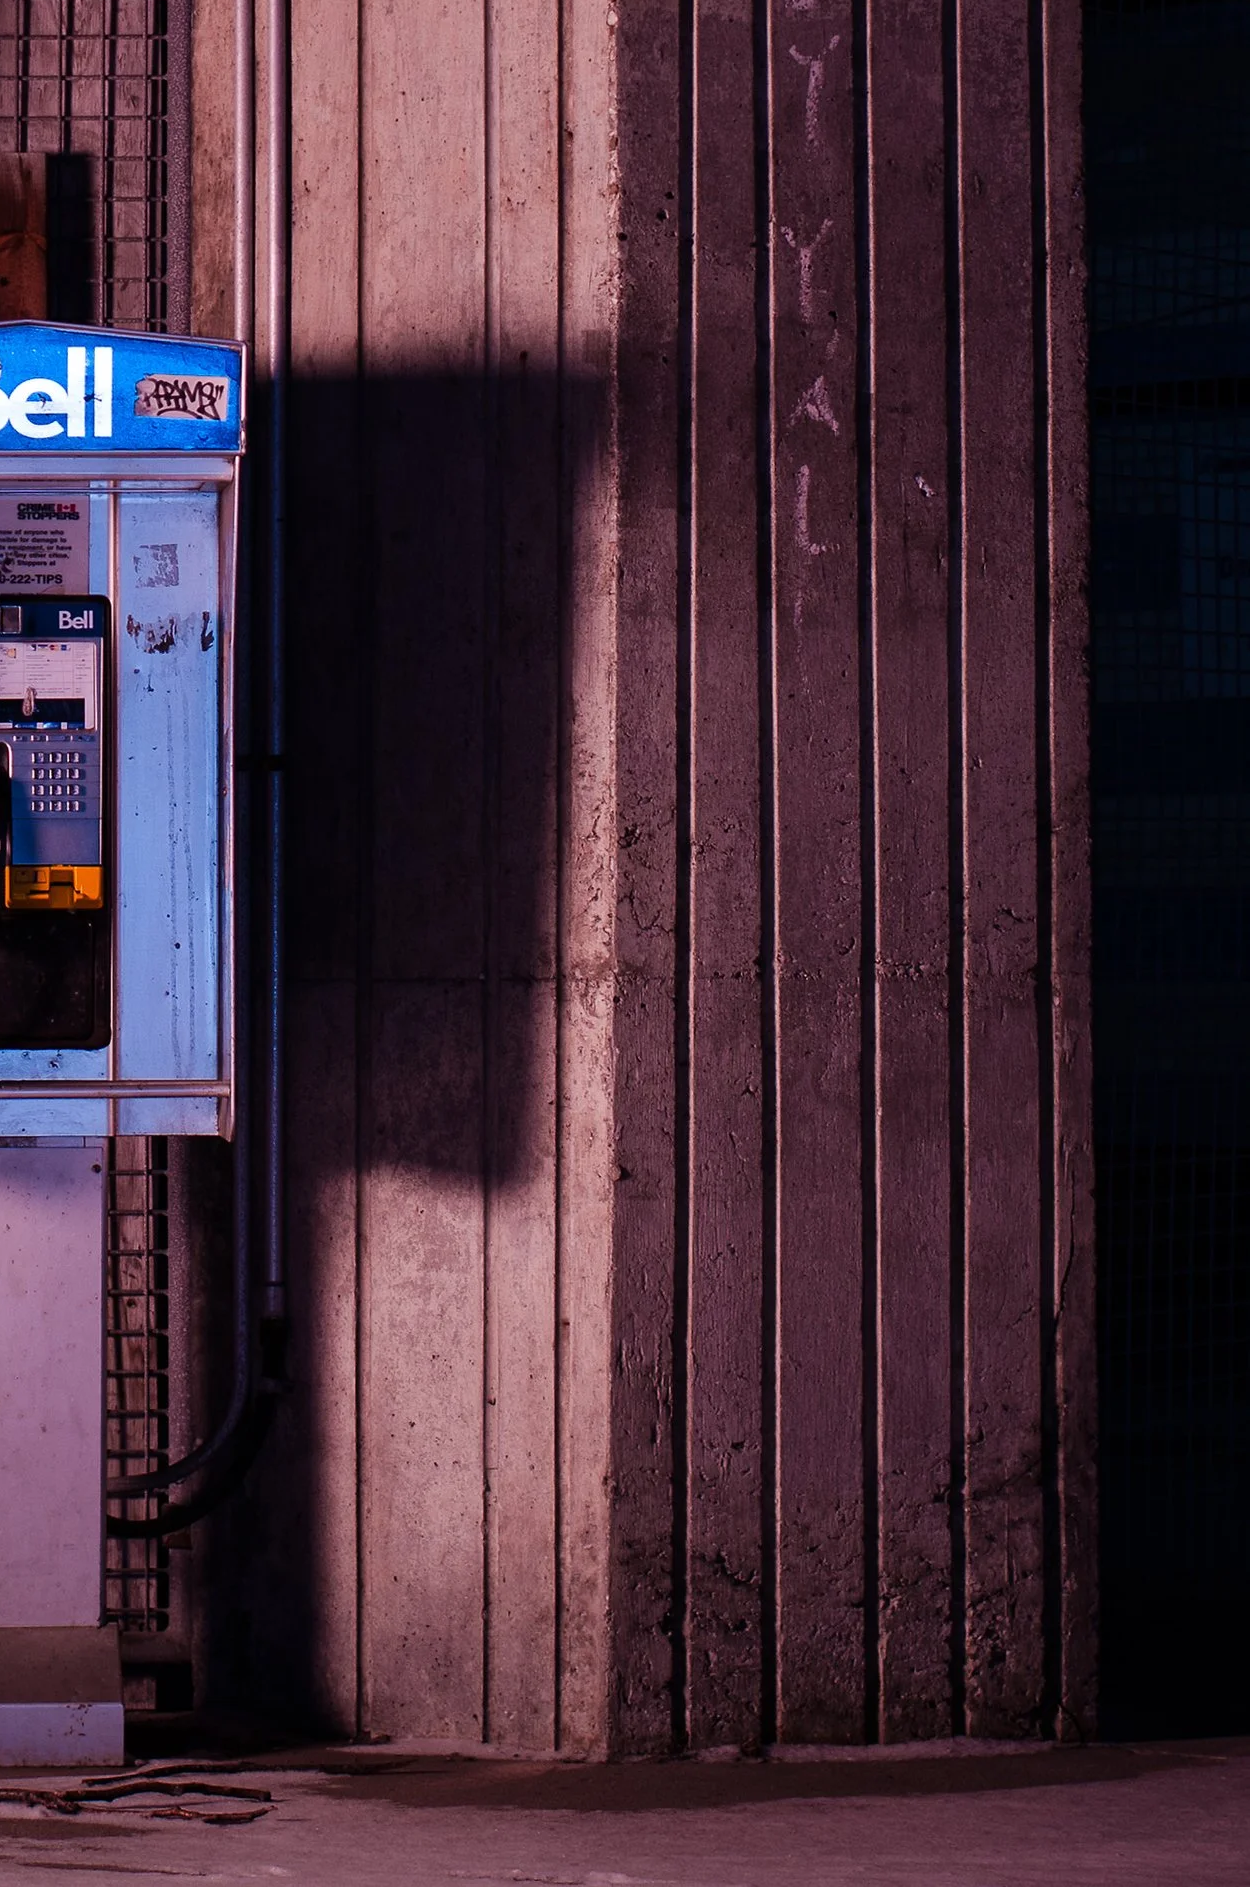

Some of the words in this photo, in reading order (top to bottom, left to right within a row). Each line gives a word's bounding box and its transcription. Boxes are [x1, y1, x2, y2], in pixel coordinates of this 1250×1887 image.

[17, 503, 56, 513] CRIME
[17, 512, 80, 521] STOPPERS
[7, 544, 45, 552] equipment,
[17, 560, 48, 568] Stoppers
[59, 610, 94, 630] Bell
